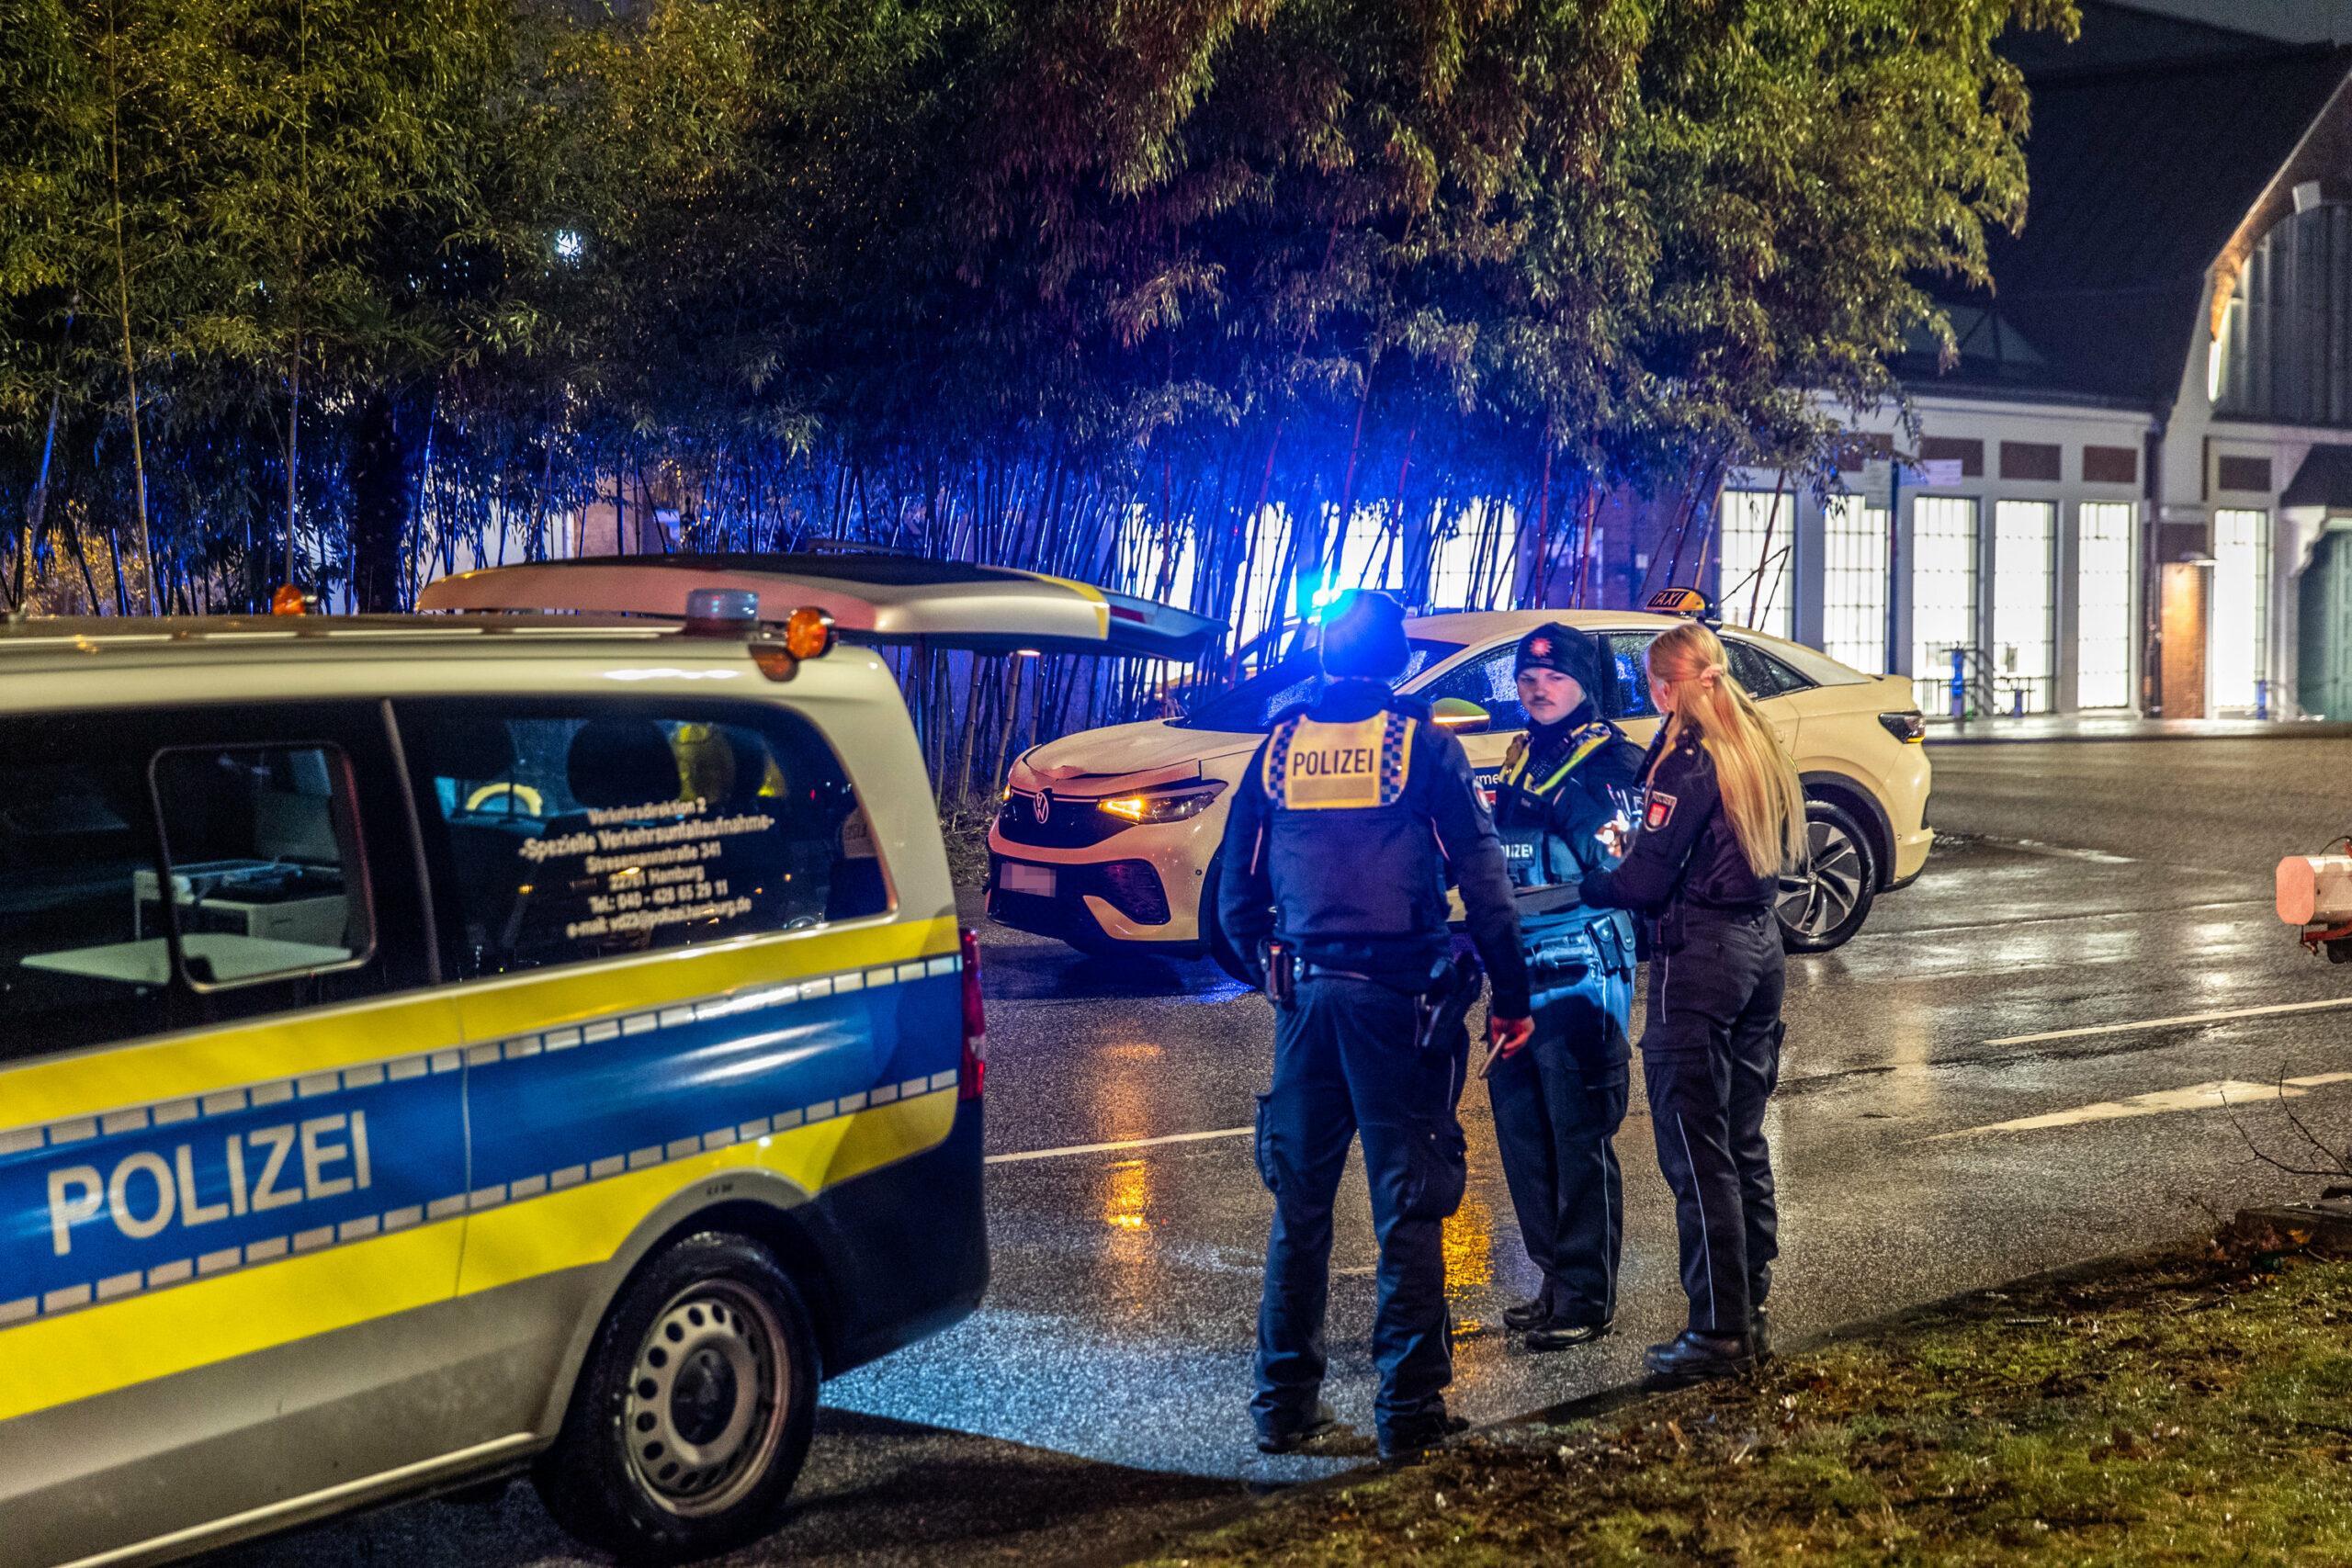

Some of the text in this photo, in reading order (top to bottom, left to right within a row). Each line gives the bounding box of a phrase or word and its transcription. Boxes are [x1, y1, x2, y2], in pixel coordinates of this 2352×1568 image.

[1650, 591, 1685, 606] TAXI
[1293, 748, 1374, 776] POLIZEI
[695, 796, 707, 814] 2
[699, 840, 721, 860] 341
[1500, 843, 1533, 859] LIZEI
[648, 864, 705, 885] Hamburg
[616, 890, 642, 910] 040
[715, 878, 729, 896] 11
[47, 1111, 371, 1256] POLIZEI
